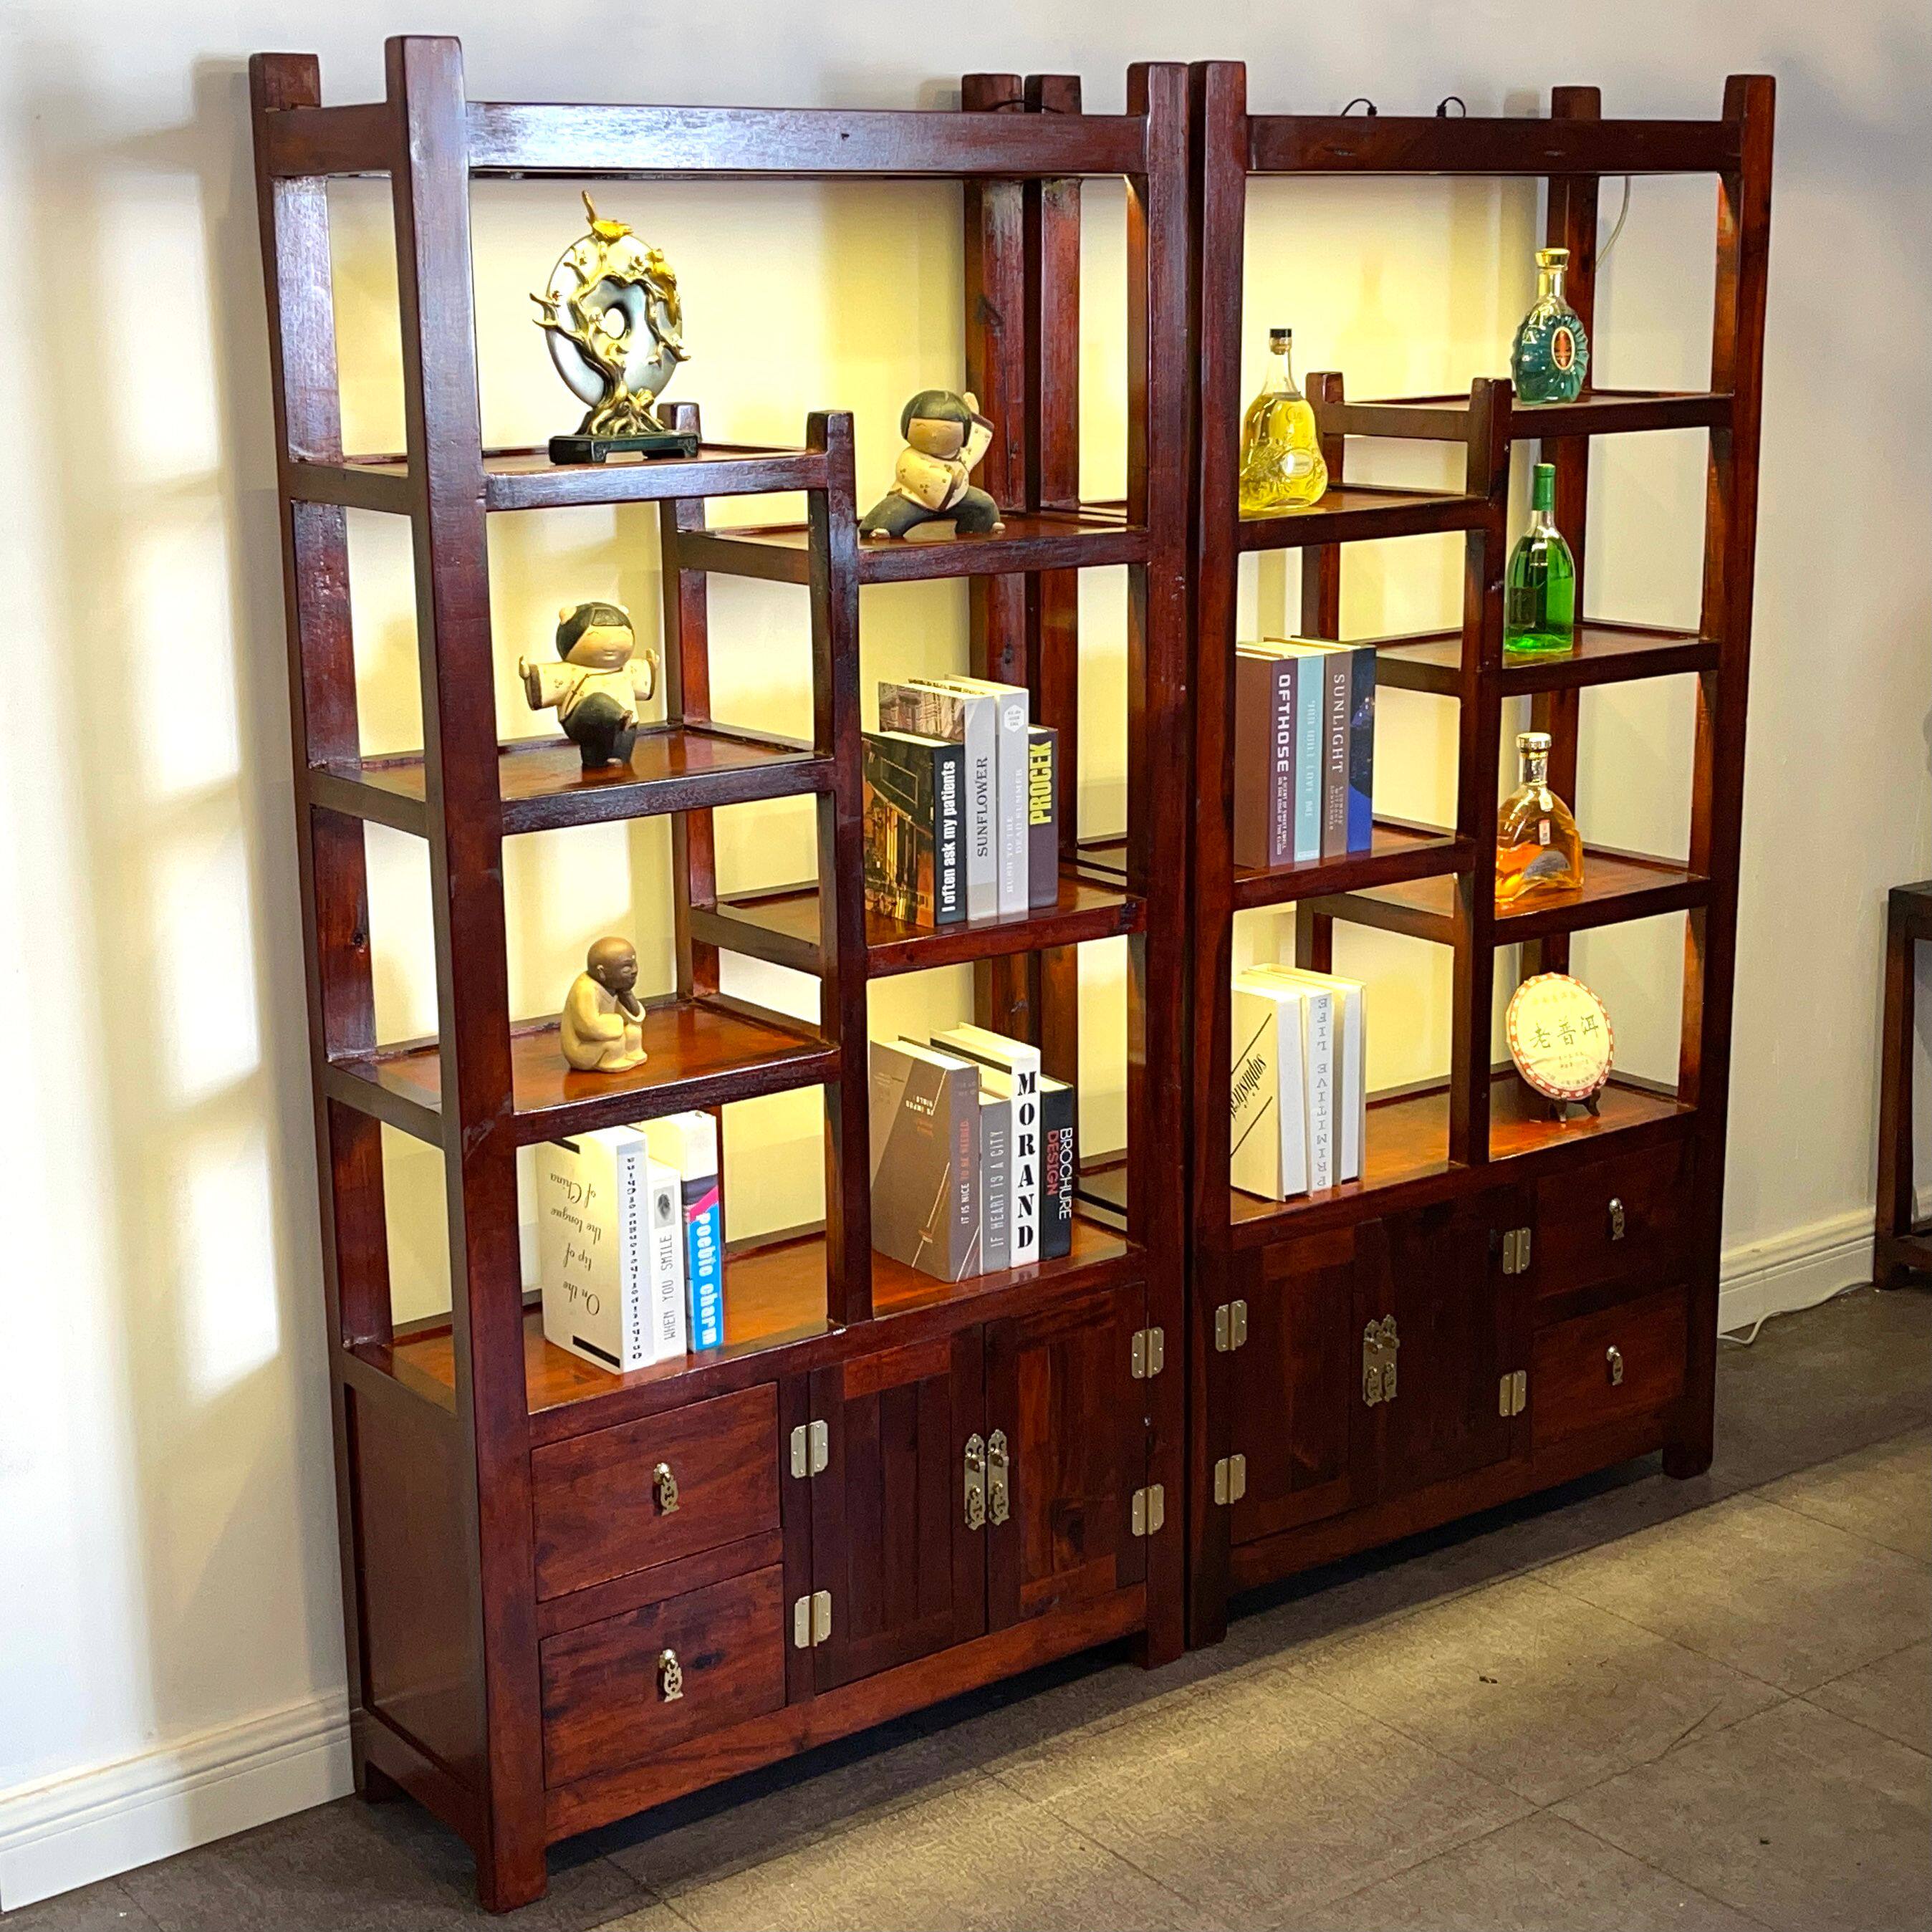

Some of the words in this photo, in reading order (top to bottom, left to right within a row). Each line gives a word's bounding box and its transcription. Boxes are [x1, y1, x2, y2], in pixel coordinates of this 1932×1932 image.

[1277, 674, 1291, 773] OFTHOSE
[1332, 674, 1345, 773] SUNLIGHT
[942, 761, 957, 816] patients
[1029, 741, 1052, 826] PROCEK
[976, 756, 989, 857] SUNFLOWER
[943, 820, 958, 839] my
[942, 843, 956, 866] ask
[942, 868, 956, 903] often
[989, 1130, 1004, 1157] CITY
[1017, 1071, 1037, 1249] MORAND
[1047, 1130, 1059, 1196] DESIGN
[989, 1175, 1004, 1188] IS
[1059, 1127, 1073, 1221] BROCHURE
[549, 1172, 582, 1204] China
[585, 1183, 597, 1209] of
[961, 1183, 969, 1203] NICE
[549, 1206, 583, 1233] tongue
[961, 1205, 969, 1213] IS
[961, 1216, 969, 1225] IT
[989, 1193, 1004, 1230] HEART
[586, 1224, 602, 1244] the
[990, 1236, 1004, 1247] IF
[563, 1242, 575, 1267] of
[578, 1249, 592, 1272] tip
[659, 1234, 673, 1271] SMILE
[563, 1281, 578, 1304] the
[581, 1289, 600, 1316] On
[661, 1279, 674, 1302] YOU
[663, 1309, 676, 1341] WHEN
[699, 1282, 718, 1345] charm
